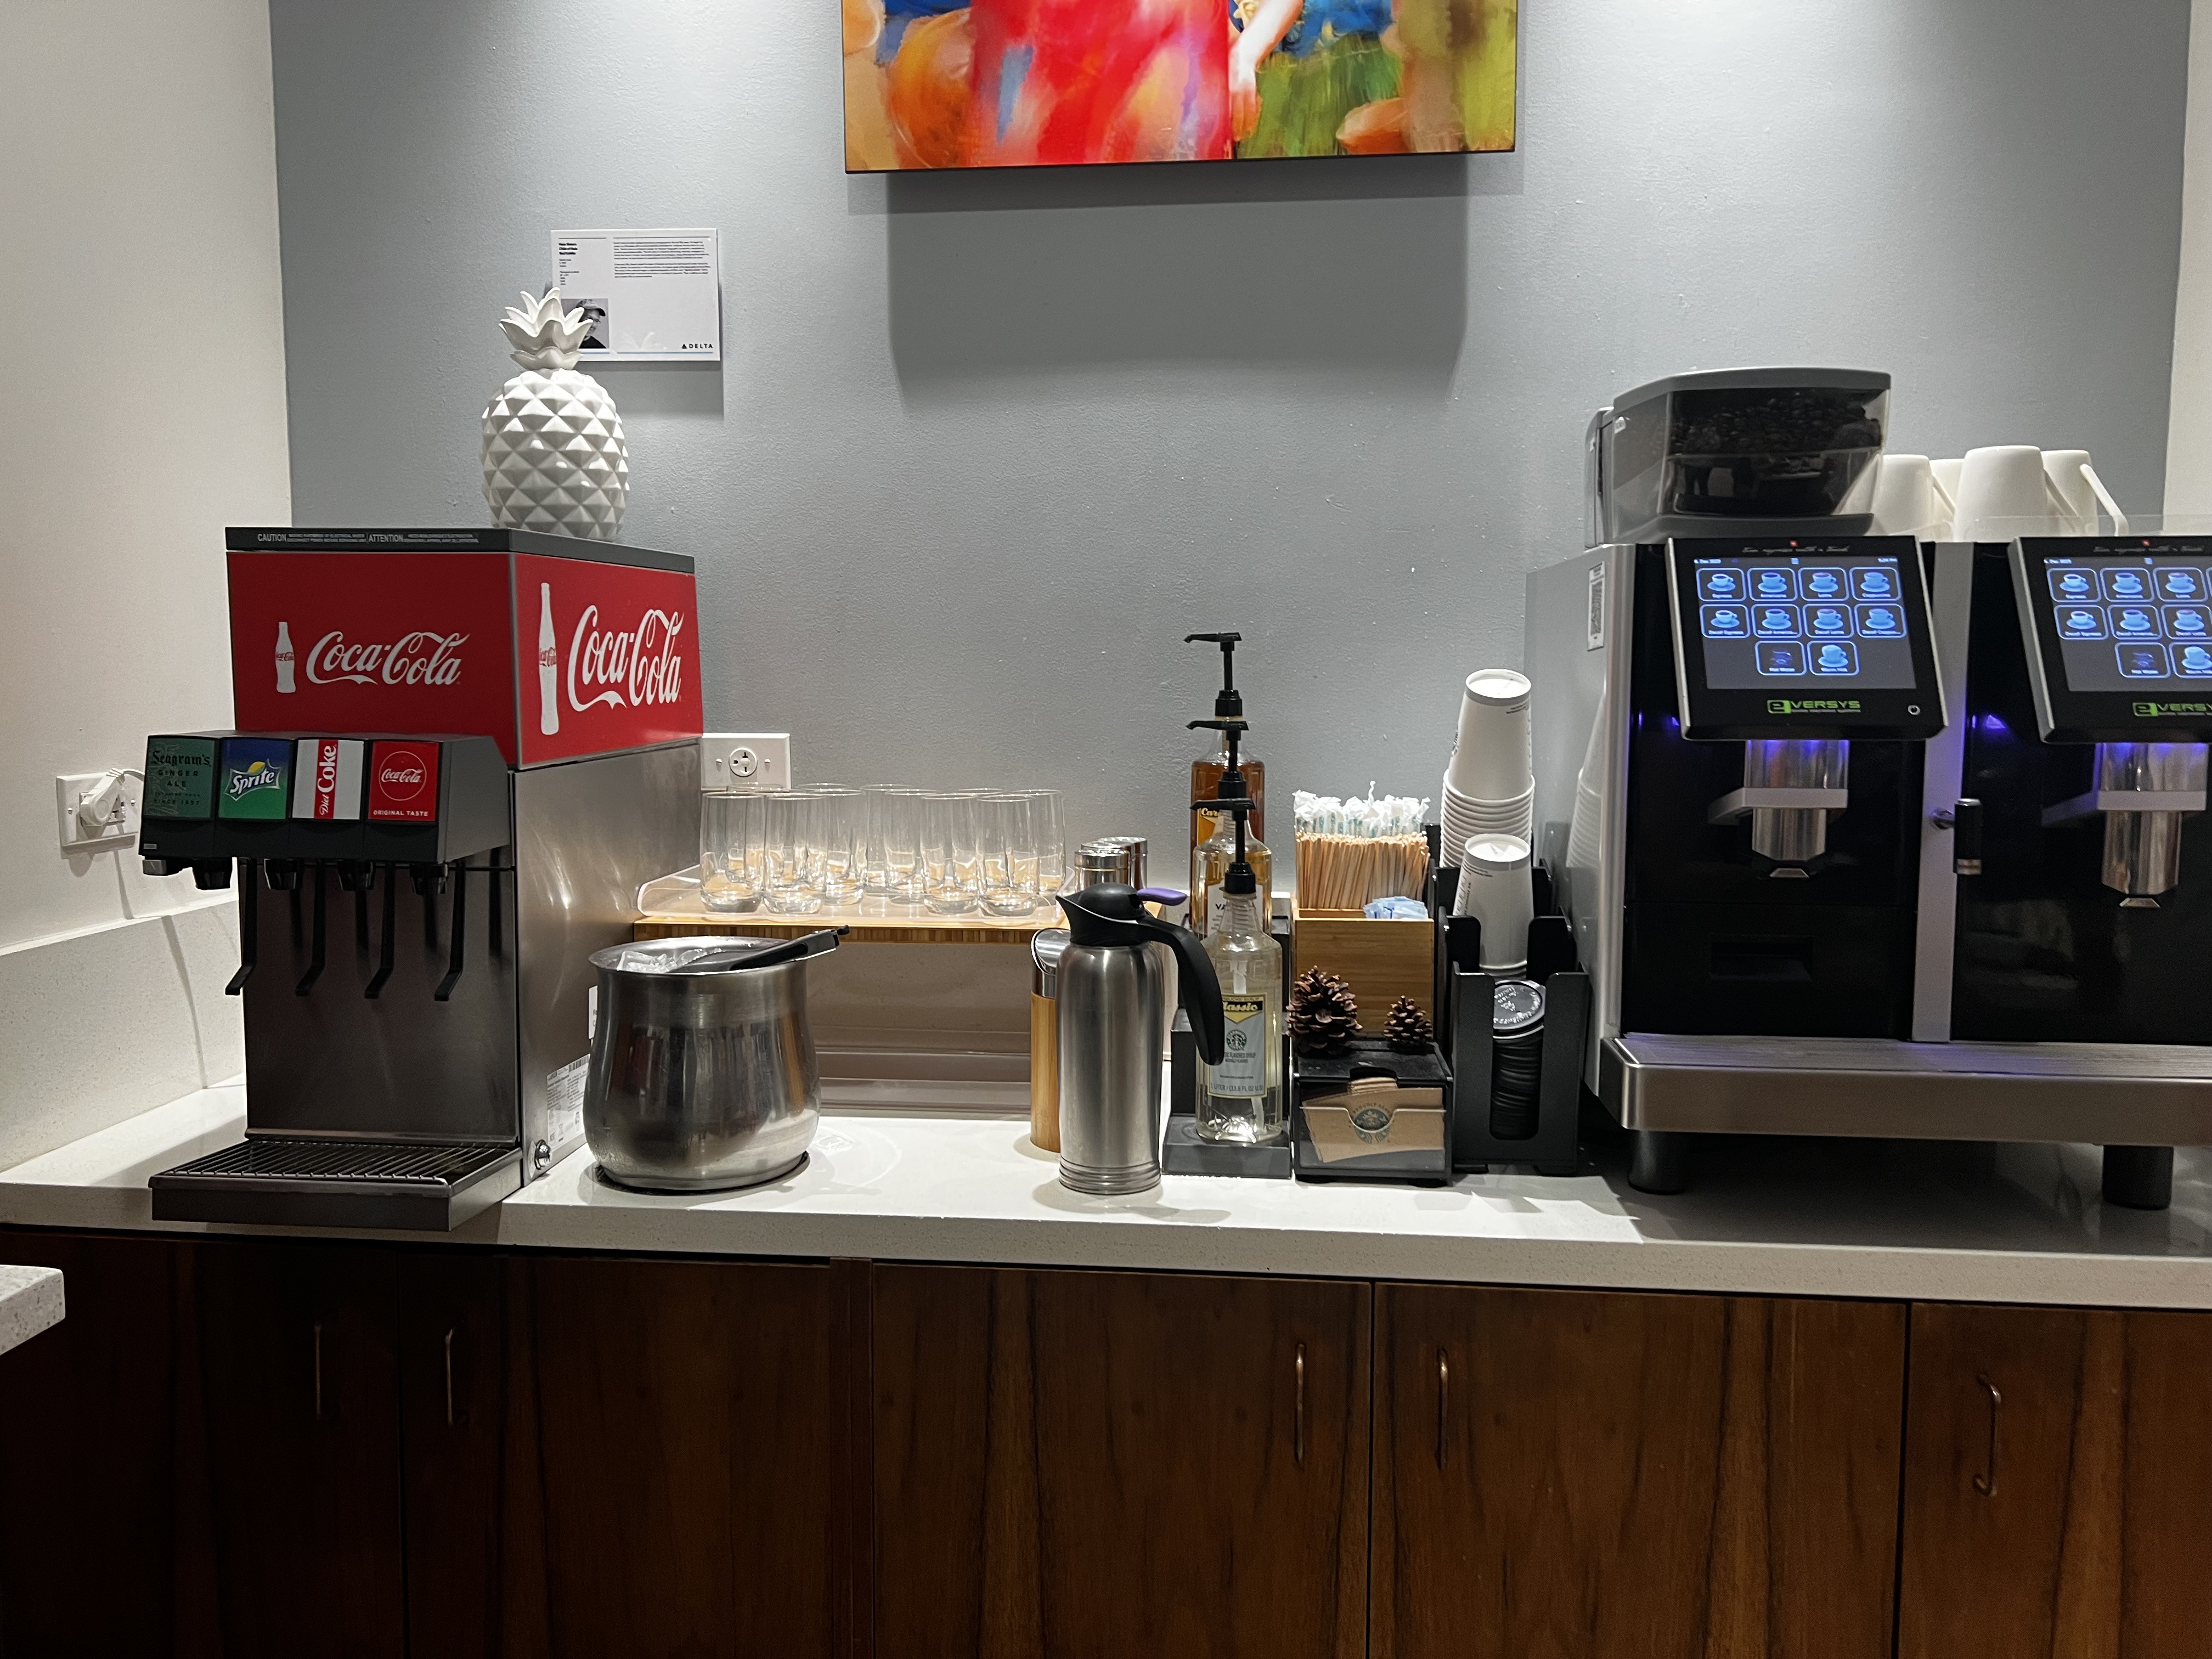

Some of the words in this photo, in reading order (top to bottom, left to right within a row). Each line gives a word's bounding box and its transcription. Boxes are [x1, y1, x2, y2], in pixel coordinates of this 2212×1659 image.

[306, 631, 470, 685] Coca-Cola
[567, 605, 684, 712] Coca-Cola
[151, 751, 211, 766] Seagram's
[317, 746, 336, 793] Coke
[230, 767, 275, 794] Sprite
[319, 794, 329, 815] Diet
[1222, 1002, 1258, 1011] lassic
